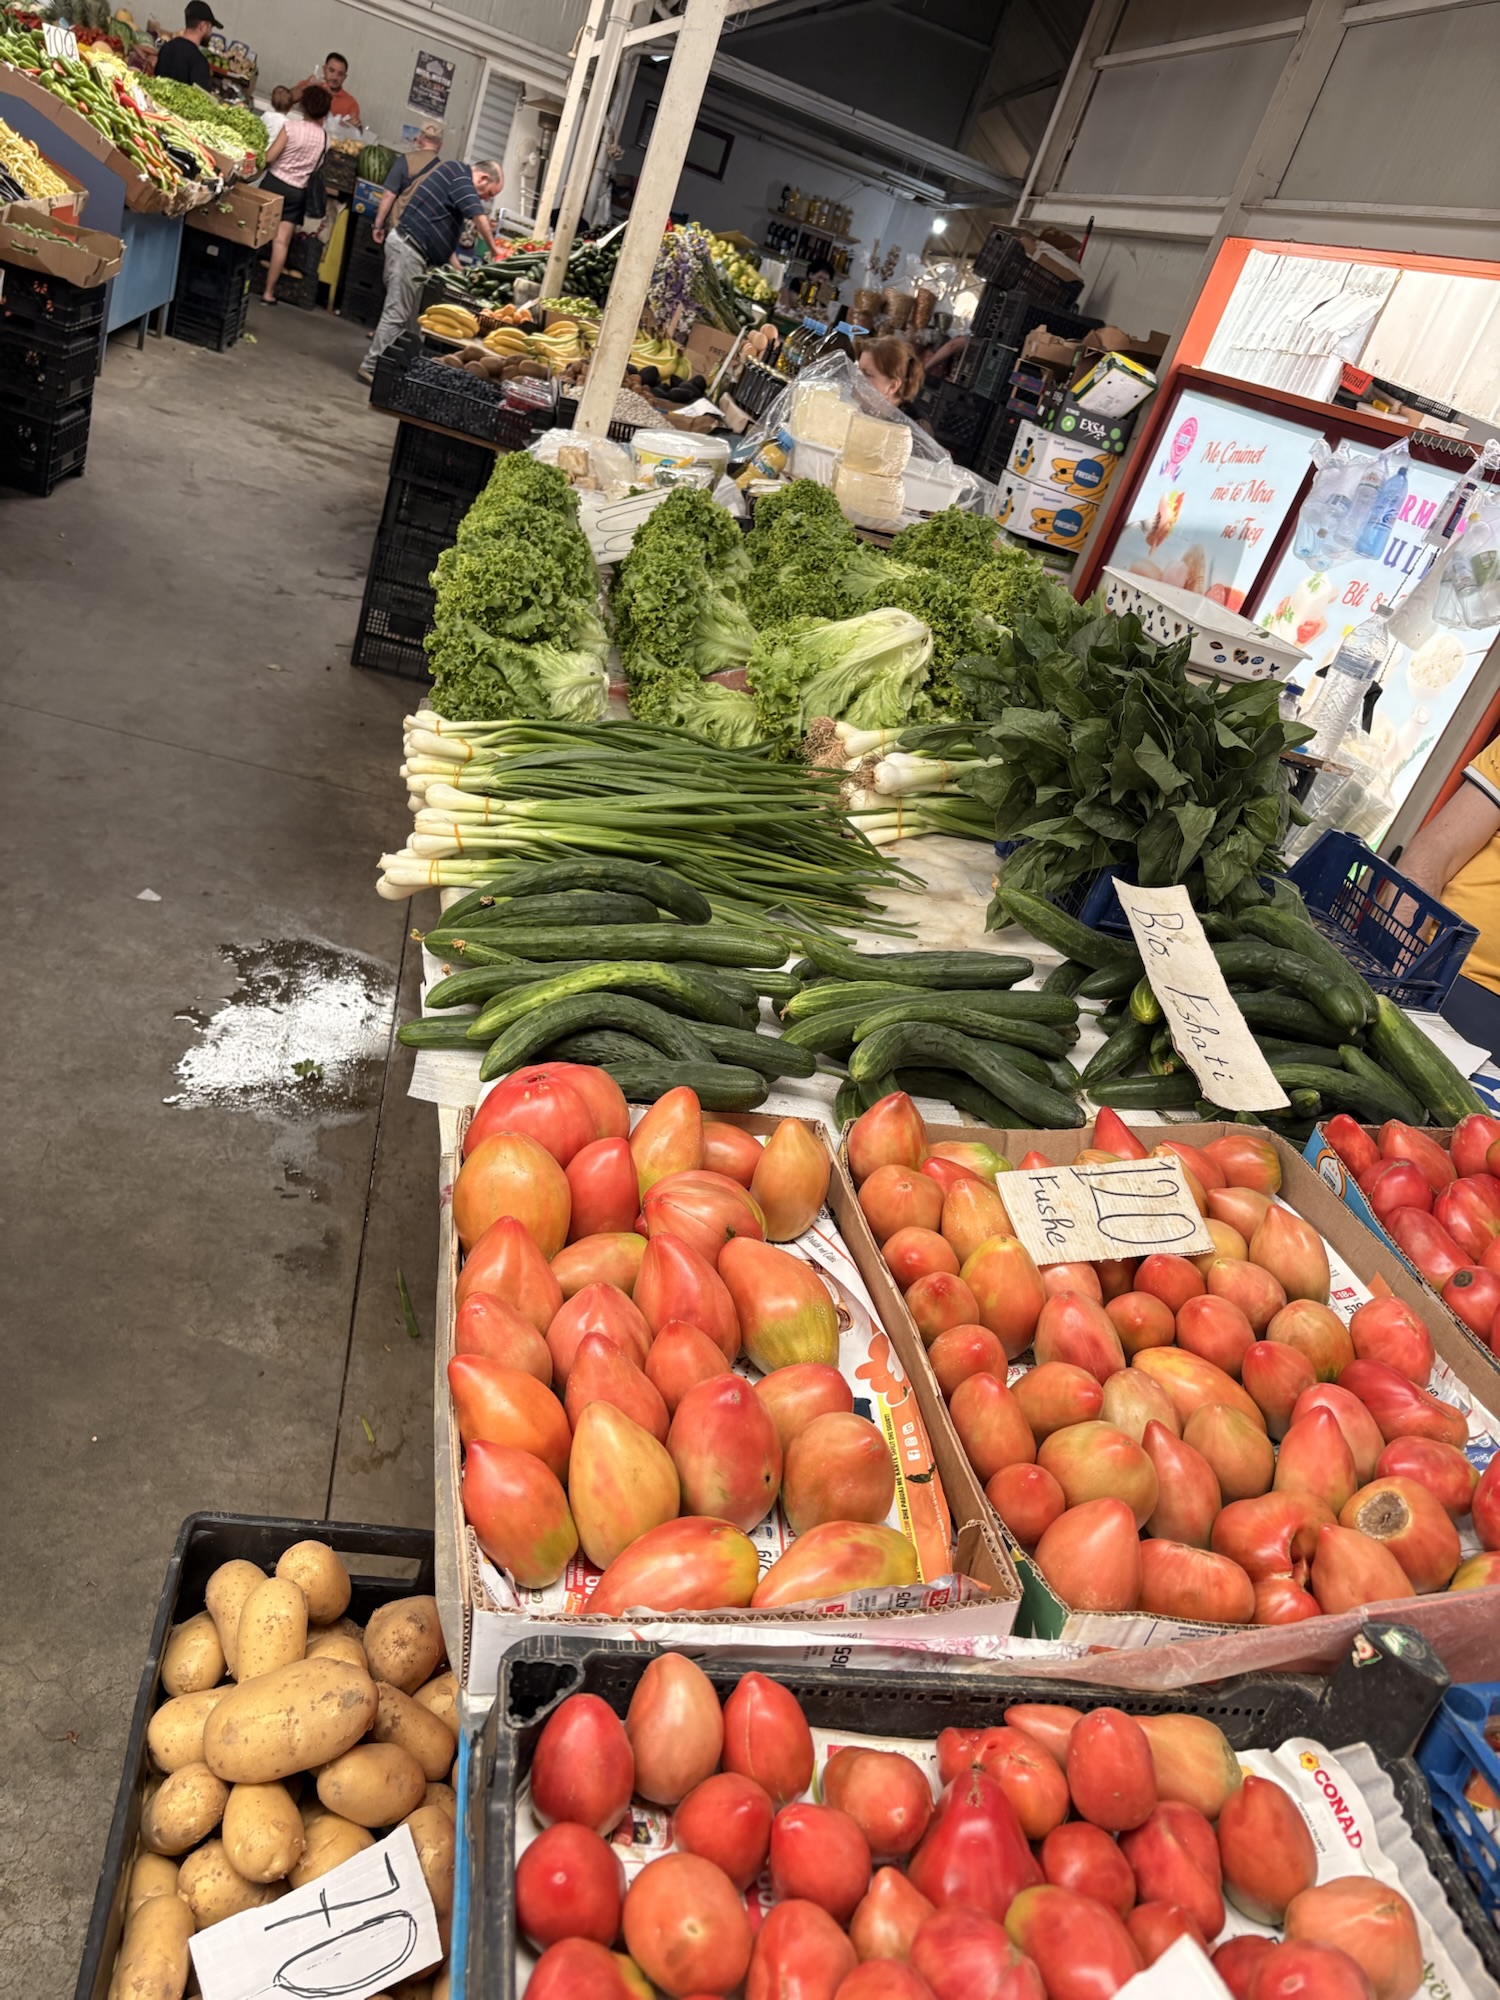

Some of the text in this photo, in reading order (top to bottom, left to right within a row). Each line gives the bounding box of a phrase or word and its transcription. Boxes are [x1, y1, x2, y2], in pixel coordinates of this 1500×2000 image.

[1200, 441, 1222, 464] Me
[1028, 1175, 1075, 1248] Fushe
[1069, 1161, 1196, 1244] 120
[1314, 1769, 1363, 1849] CONAD
